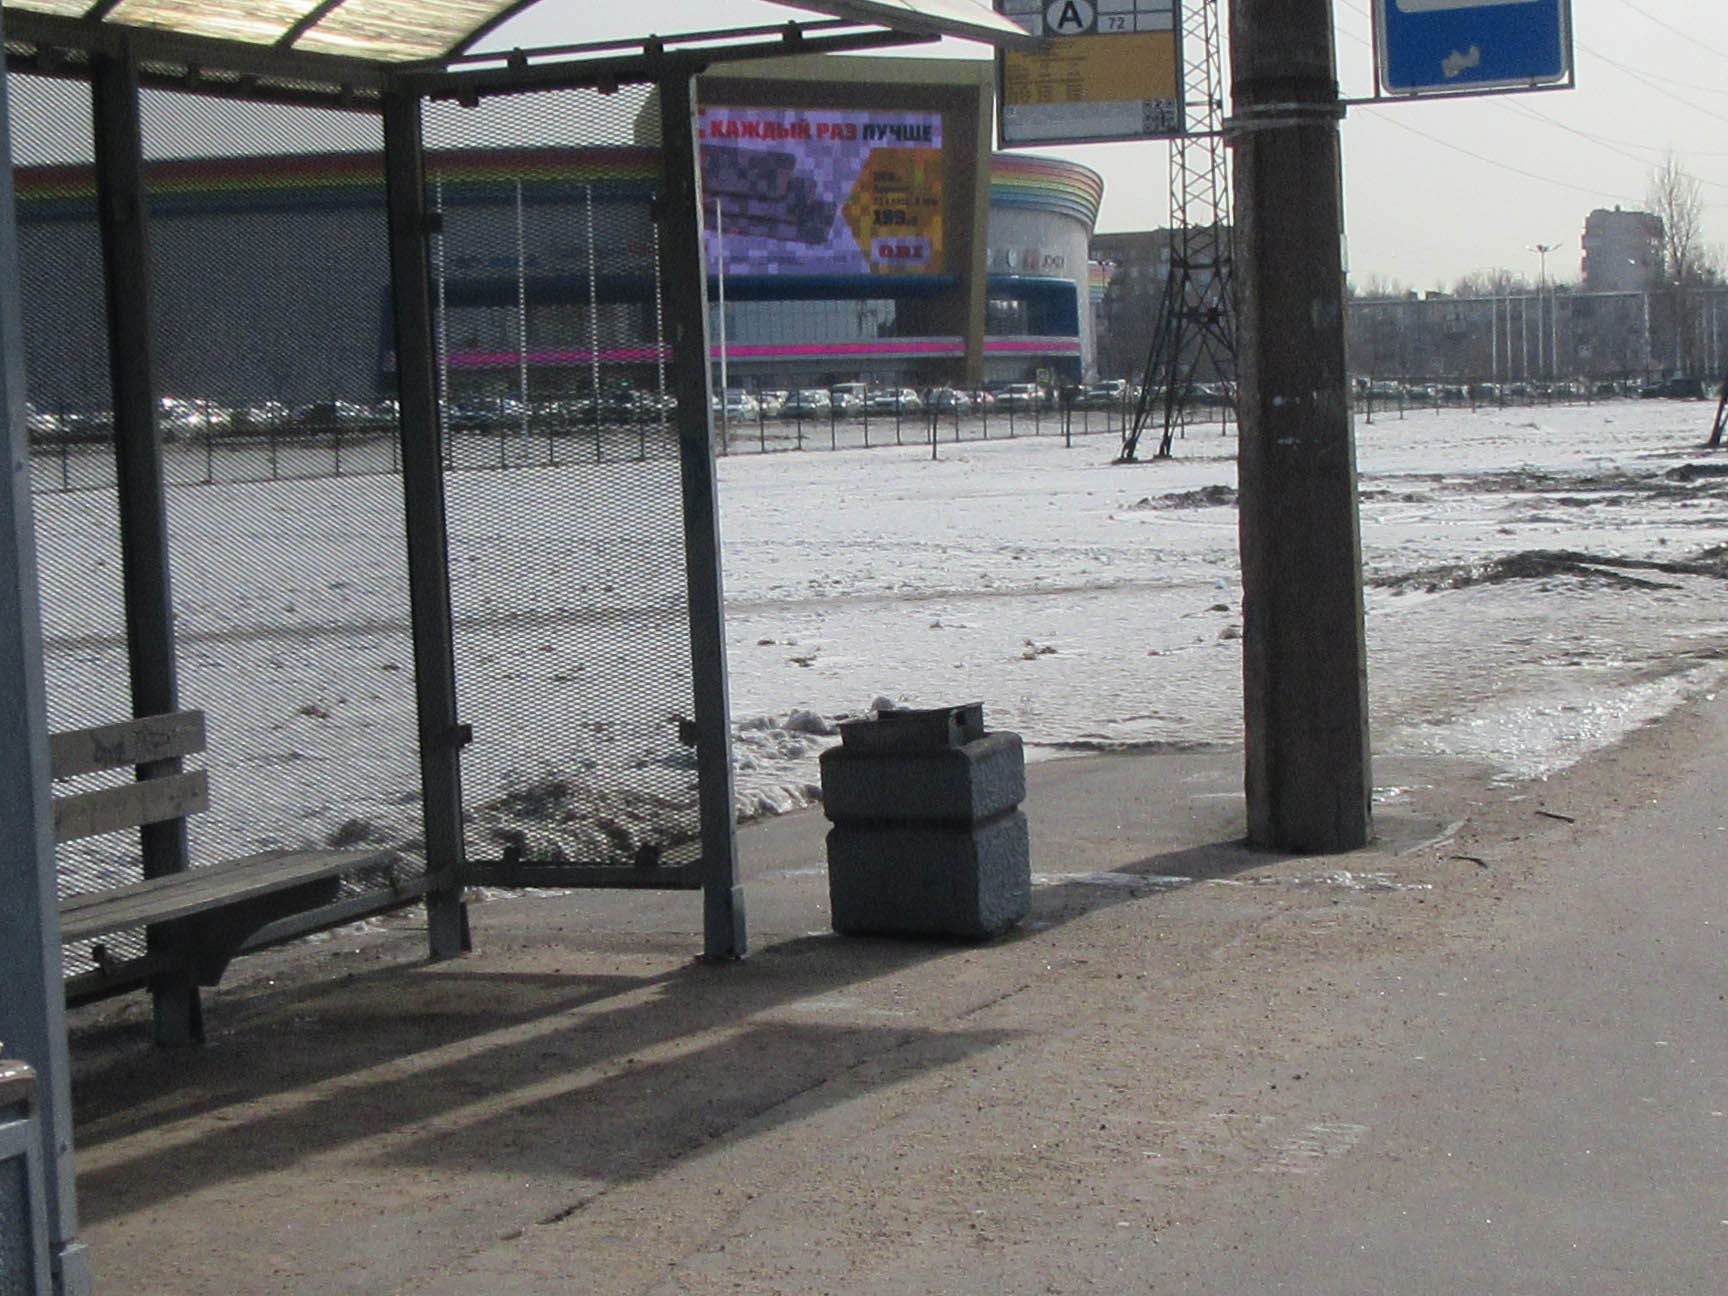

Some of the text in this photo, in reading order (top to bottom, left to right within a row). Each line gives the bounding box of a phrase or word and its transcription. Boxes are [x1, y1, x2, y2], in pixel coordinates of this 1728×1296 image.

[1108, 16, 1125, 30] 72
[710, 119, 933, 142] КАЖДЫЙ РАЗ ЛУЧШЕ
